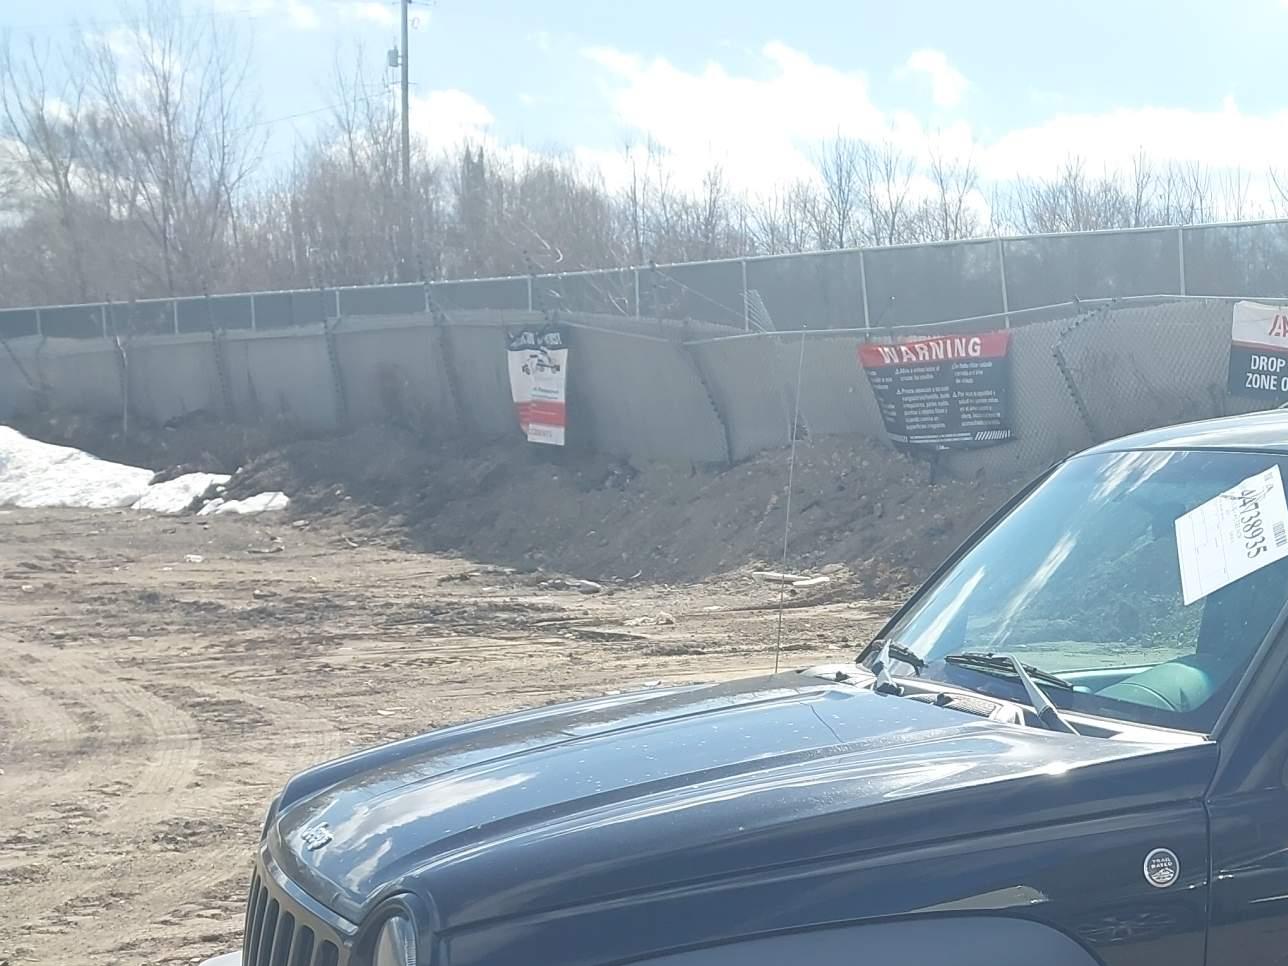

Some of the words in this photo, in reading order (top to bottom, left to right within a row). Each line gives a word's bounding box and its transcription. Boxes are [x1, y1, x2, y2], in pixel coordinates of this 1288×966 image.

[870, 336, 982, 364] WARNING
[1250, 354, 1286, 373] DROP
[1245, 372, 1277, 390] ZONE
